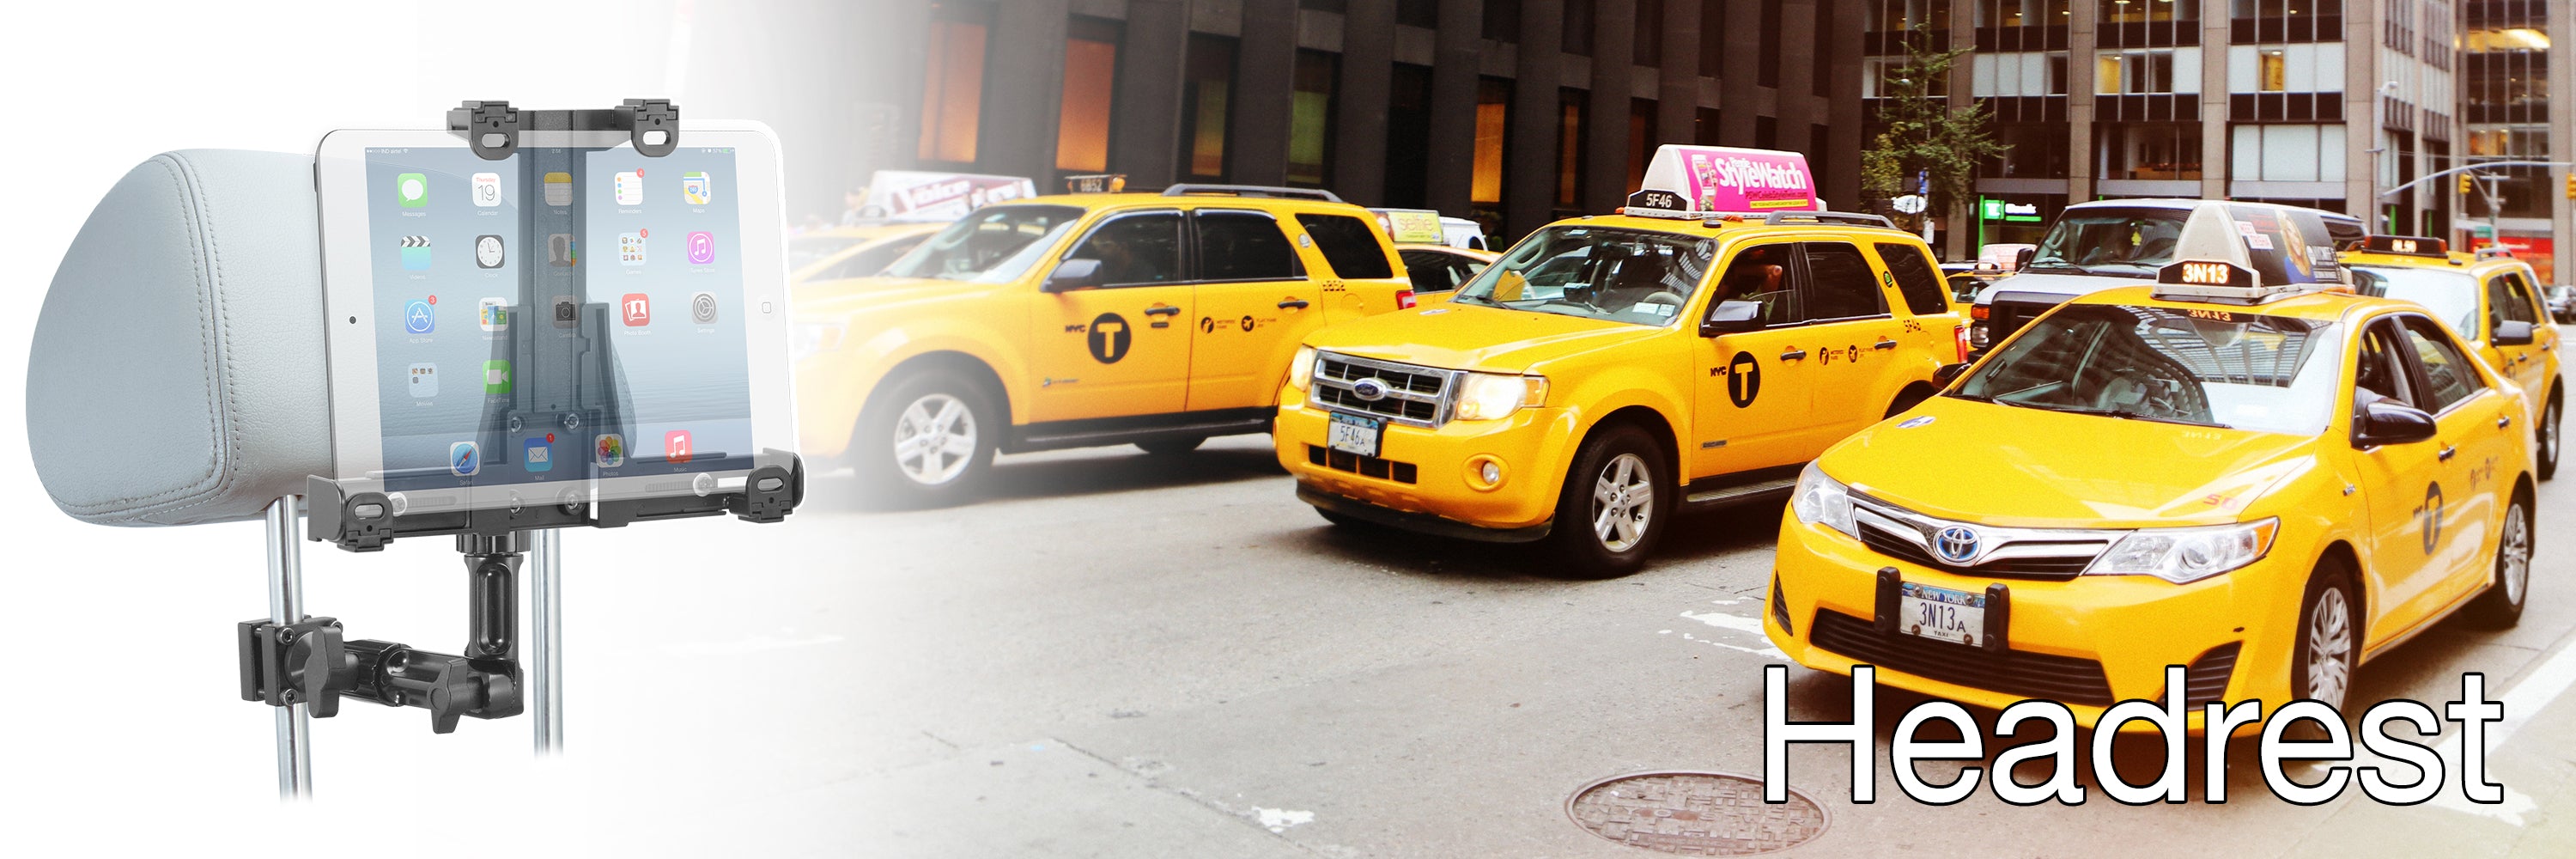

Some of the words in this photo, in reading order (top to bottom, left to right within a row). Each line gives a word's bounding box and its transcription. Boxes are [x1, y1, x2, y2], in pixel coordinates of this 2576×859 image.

[1715, 158, 1807, 195] StyleWatch
[478, 185, 495, 201] 19
[1646, 193, 1673, 208] 5F46
[2182, 264, 2228, 283] 3N13
[1097, 322, 1122, 357] T
[1710, 366, 1727, 376] NYC
[1735, 362, 1753, 400] T
[1922, 588, 1941, 601] NEW
[1943, 592, 1966, 606] YORK
